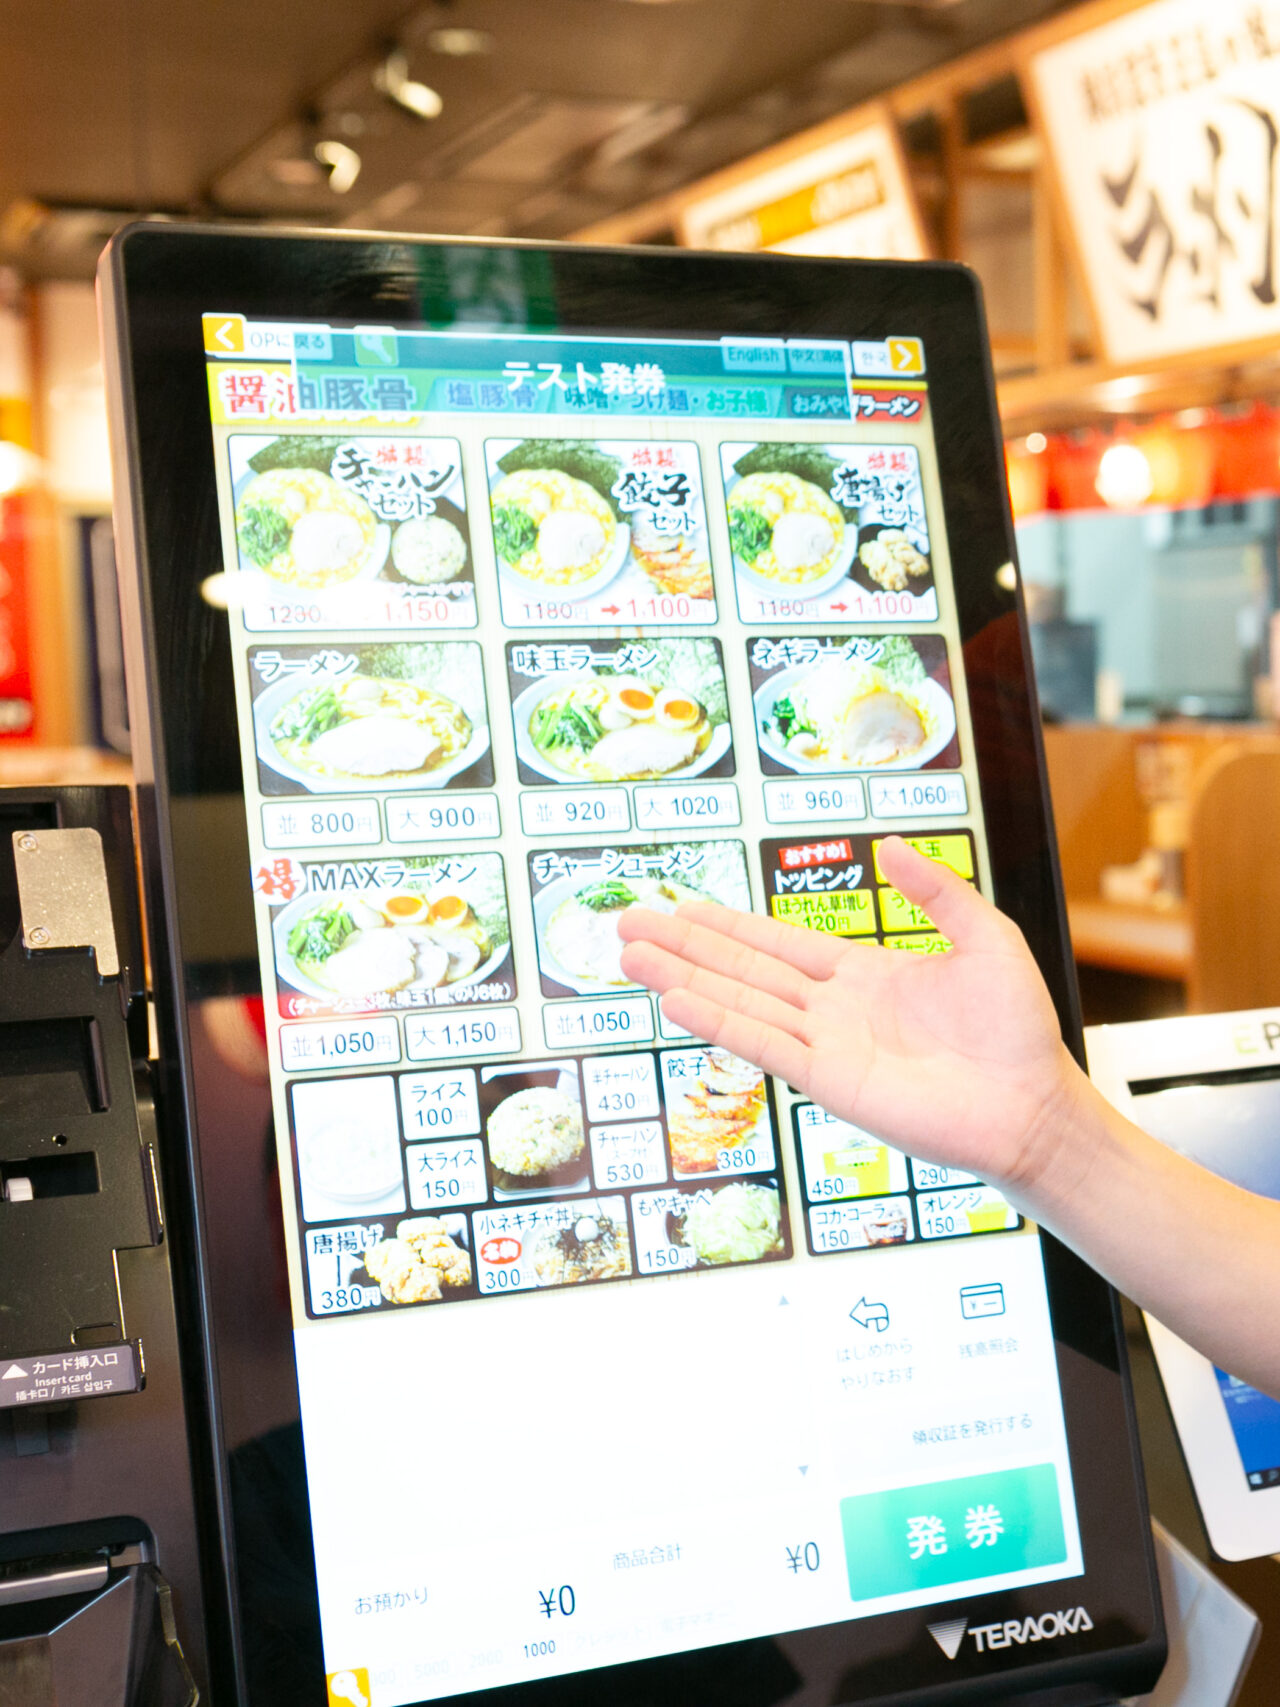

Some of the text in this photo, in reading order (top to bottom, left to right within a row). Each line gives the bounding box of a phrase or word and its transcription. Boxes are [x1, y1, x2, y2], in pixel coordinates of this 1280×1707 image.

[727, 345, 780, 364] English
[501, 361, 667, 396] テスト発券
[225, 373, 414, 415] 醤油豚骨
[619, 472, 691, 508] 餃子
[373, 493, 431, 516] セット
[876, 504, 919, 523] セット
[648, 511, 697, 532] セット
[517, 645, 658, 672] 味玉ラーメン
[757, 640, 882, 665] ネギラーメン
[256, 654, 355, 678] ラーメン
[537, 850, 704, 879] チャーシューメン
[309, 863, 477, 892] MAXラーメン
[775, 864, 864, 894] トッピング
[777, 894, 868, 915] ほうれん草増し
[803, 913, 851, 932] 120円
[667, 1057, 707, 1078] 餃子
[411, 1081, 467, 1103] ライス
[598, 1128, 658, 1149] チャーハン
[418, 1149, 477, 1173] 大ライス
[816, 1203, 886, 1225] コカ・コーラ
[923, 1192, 983, 1214] オレンジ
[321, 1288, 379, 1310] 380円
[32, 1352, 119, 1375] カード挿入口
[35, 1371, 92, 1388] Insert card
[912, 1413, 1033, 1445] 領収証を発行する
[612, 1542, 683, 1572] 商品合計
[786, 1541, 821, 1574] ¥0
[354, 1585, 428, 1615] お預かり
[538, 1584, 576, 1619] ¥0
[968, 1606, 1094, 1653] TERAOKA
[523, 1640, 556, 1659] 1000
